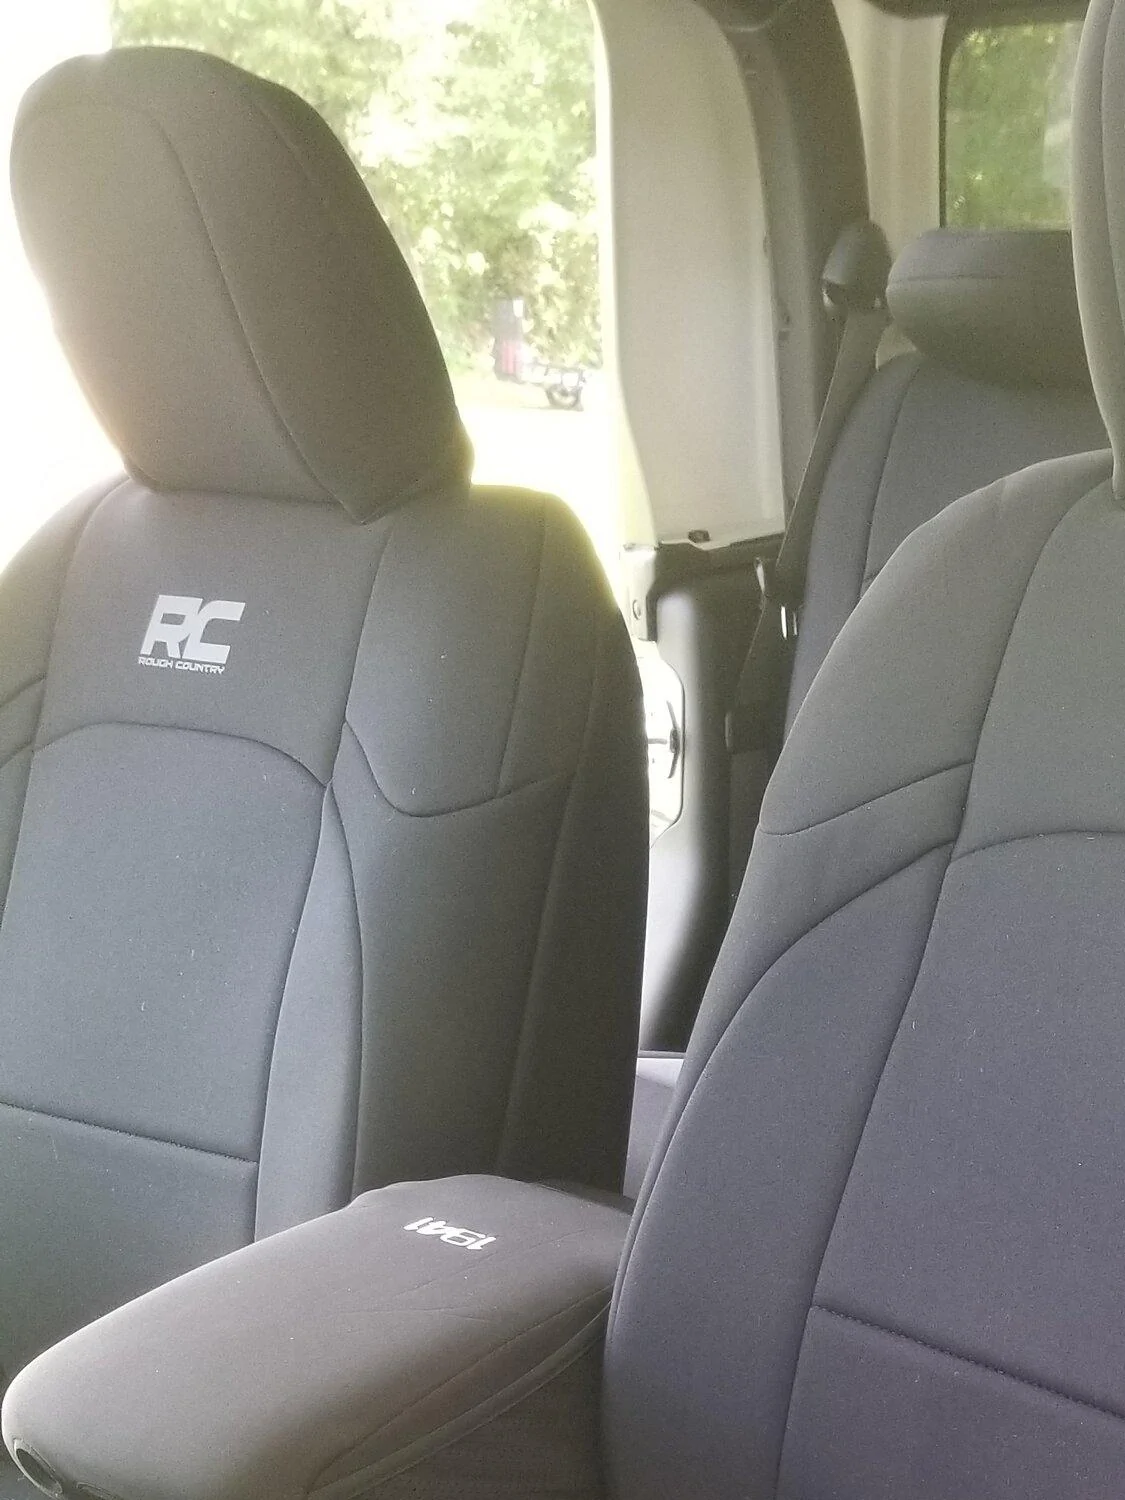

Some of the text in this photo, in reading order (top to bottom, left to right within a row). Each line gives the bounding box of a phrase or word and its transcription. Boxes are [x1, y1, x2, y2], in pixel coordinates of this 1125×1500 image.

[140, 594, 246, 664] RC
[138, 656, 225, 675] ROUGH COUNTRY
[403, 1217, 497, 1250] 1941
